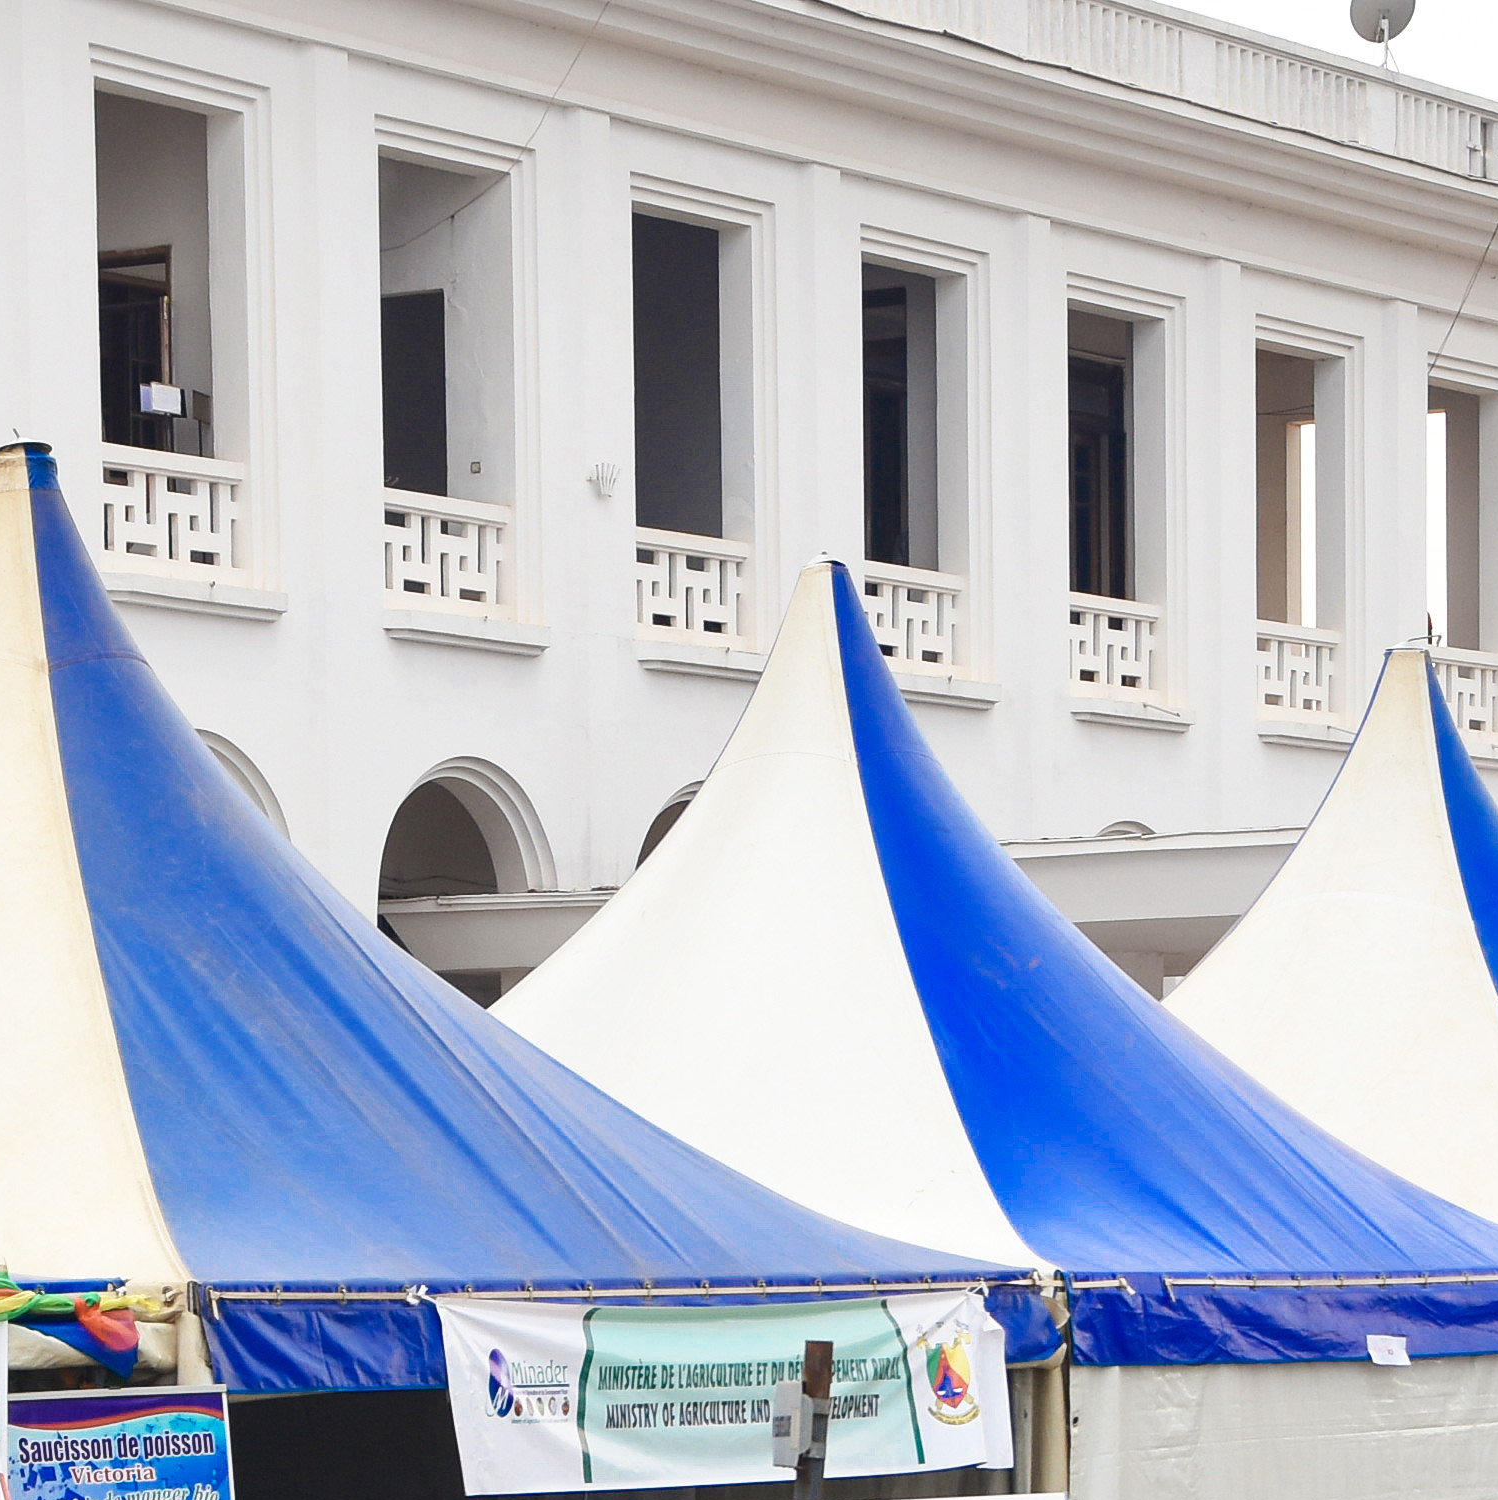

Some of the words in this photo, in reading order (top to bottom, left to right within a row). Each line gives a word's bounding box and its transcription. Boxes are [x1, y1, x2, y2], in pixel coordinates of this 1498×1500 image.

[511, 1360, 568, 1384] Minader
[599, 1358, 657, 1391] MINISTÈRE
[661, 1363, 675, 1389] DE
[678, 1361, 752, 1388] L'AGRICULTURE
[756, 1362, 768, 1386] ET
[771, 1361, 785, 1386] DU
[871, 1357, 901, 1381] RURAL
[606, 1401, 660, 1429] MINISTRY
[664, 1402, 675, 1427] OF
[678, 1400, 747, 1426] AGRICULTURE
[750, 1399, 770, 1424] AND
[18, 1435, 113, 1464] Saucisson
[117, 1434, 139, 1459] de
[143, 1430, 215, 1460] poisson
[71, 1466, 157, 1484] Victoria
